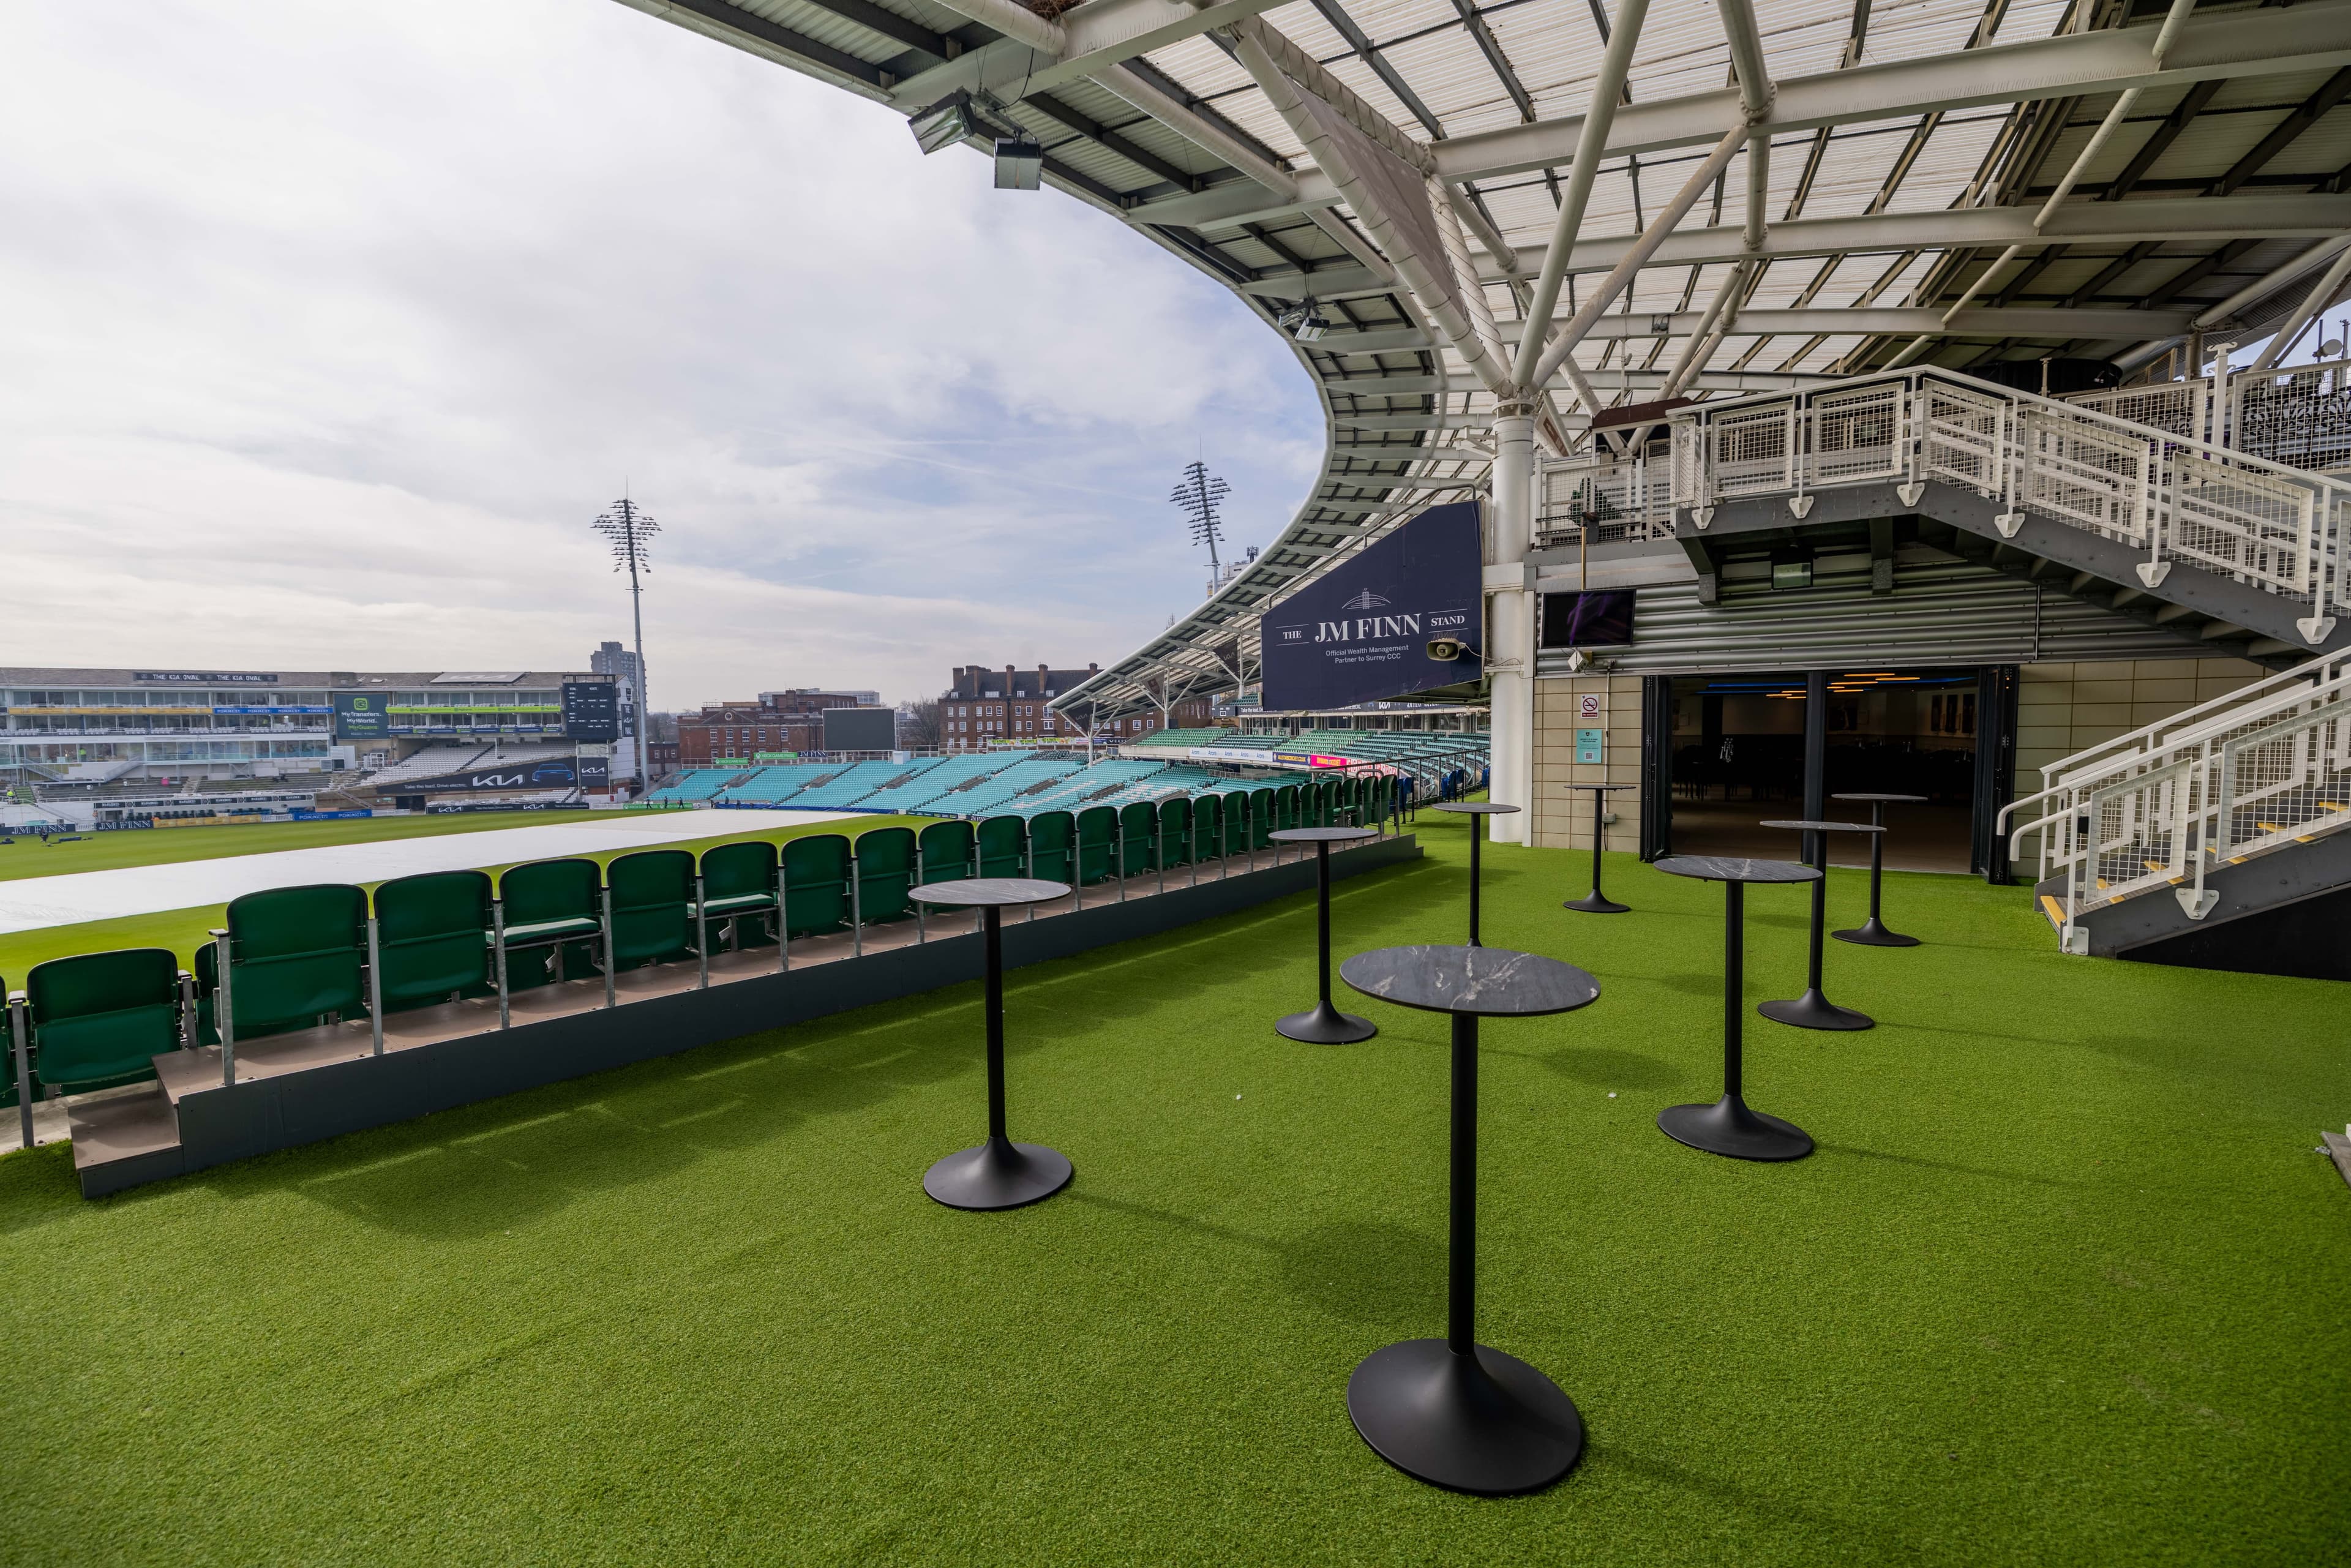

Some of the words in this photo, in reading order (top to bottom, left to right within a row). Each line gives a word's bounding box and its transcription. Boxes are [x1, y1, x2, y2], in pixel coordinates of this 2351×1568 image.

[1283, 630, 1302, 640] THE
[1314, 620, 1349, 642] JM
[1355, 613, 1422, 639] FINN
[1430, 615, 1465, 627] STAND
[1347, 647, 1368, 655] Wealth
[1368, 644, 1409, 655] Management
[1335, 656, 1357, 664] Partner
[1366, 654, 1386, 662] Surrey
[472, 774, 523, 786] KIA
